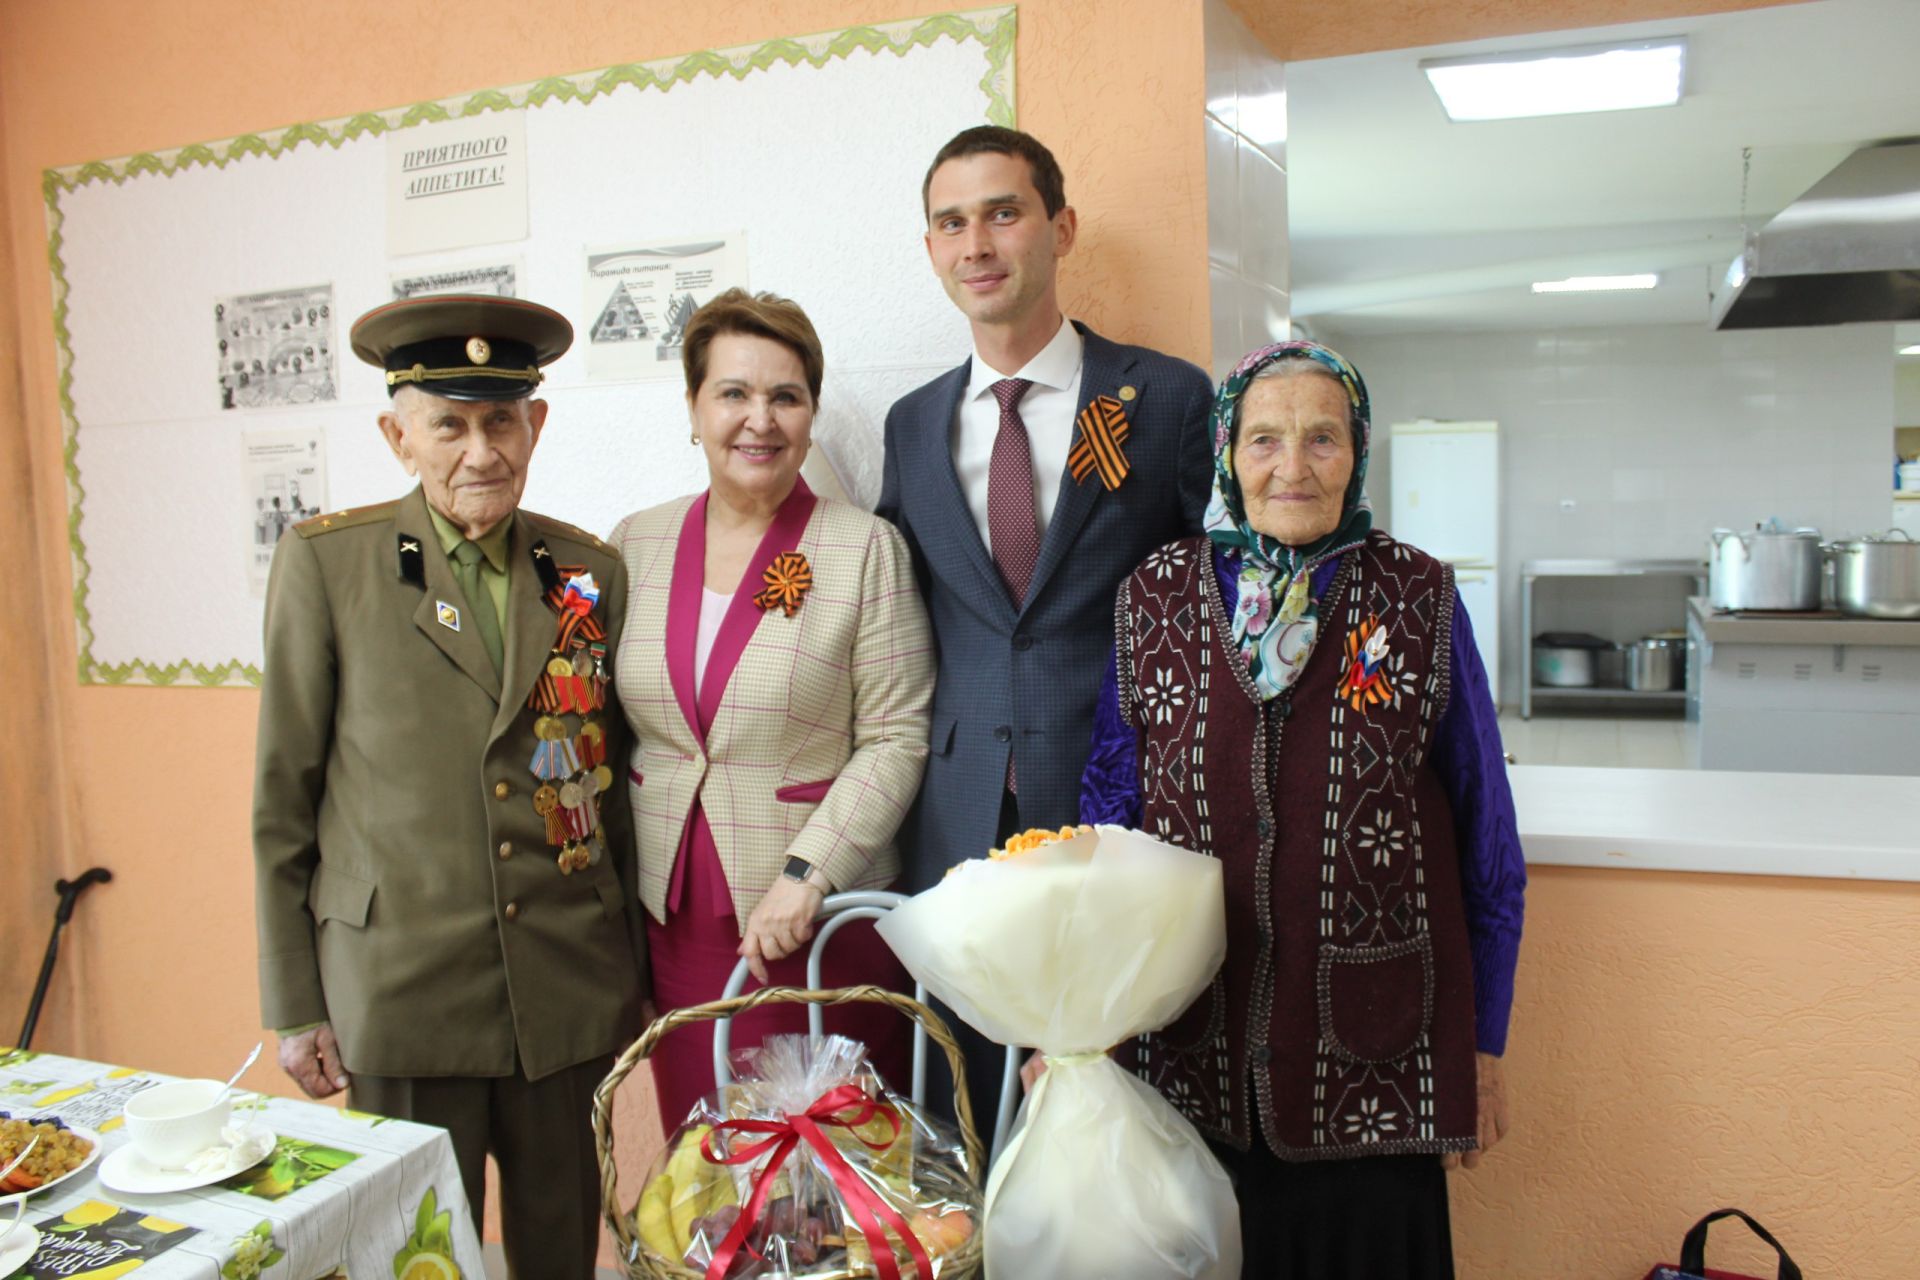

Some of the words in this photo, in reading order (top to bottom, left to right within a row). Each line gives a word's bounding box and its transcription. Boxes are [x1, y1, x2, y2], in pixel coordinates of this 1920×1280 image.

[402, 136, 508, 170] ПРИЯТНОГО
[404, 164, 504, 196] АППЕТИТА!
[590, 265, 631, 279] Пирамида
[32, 1248, 92, 1274] FRES
